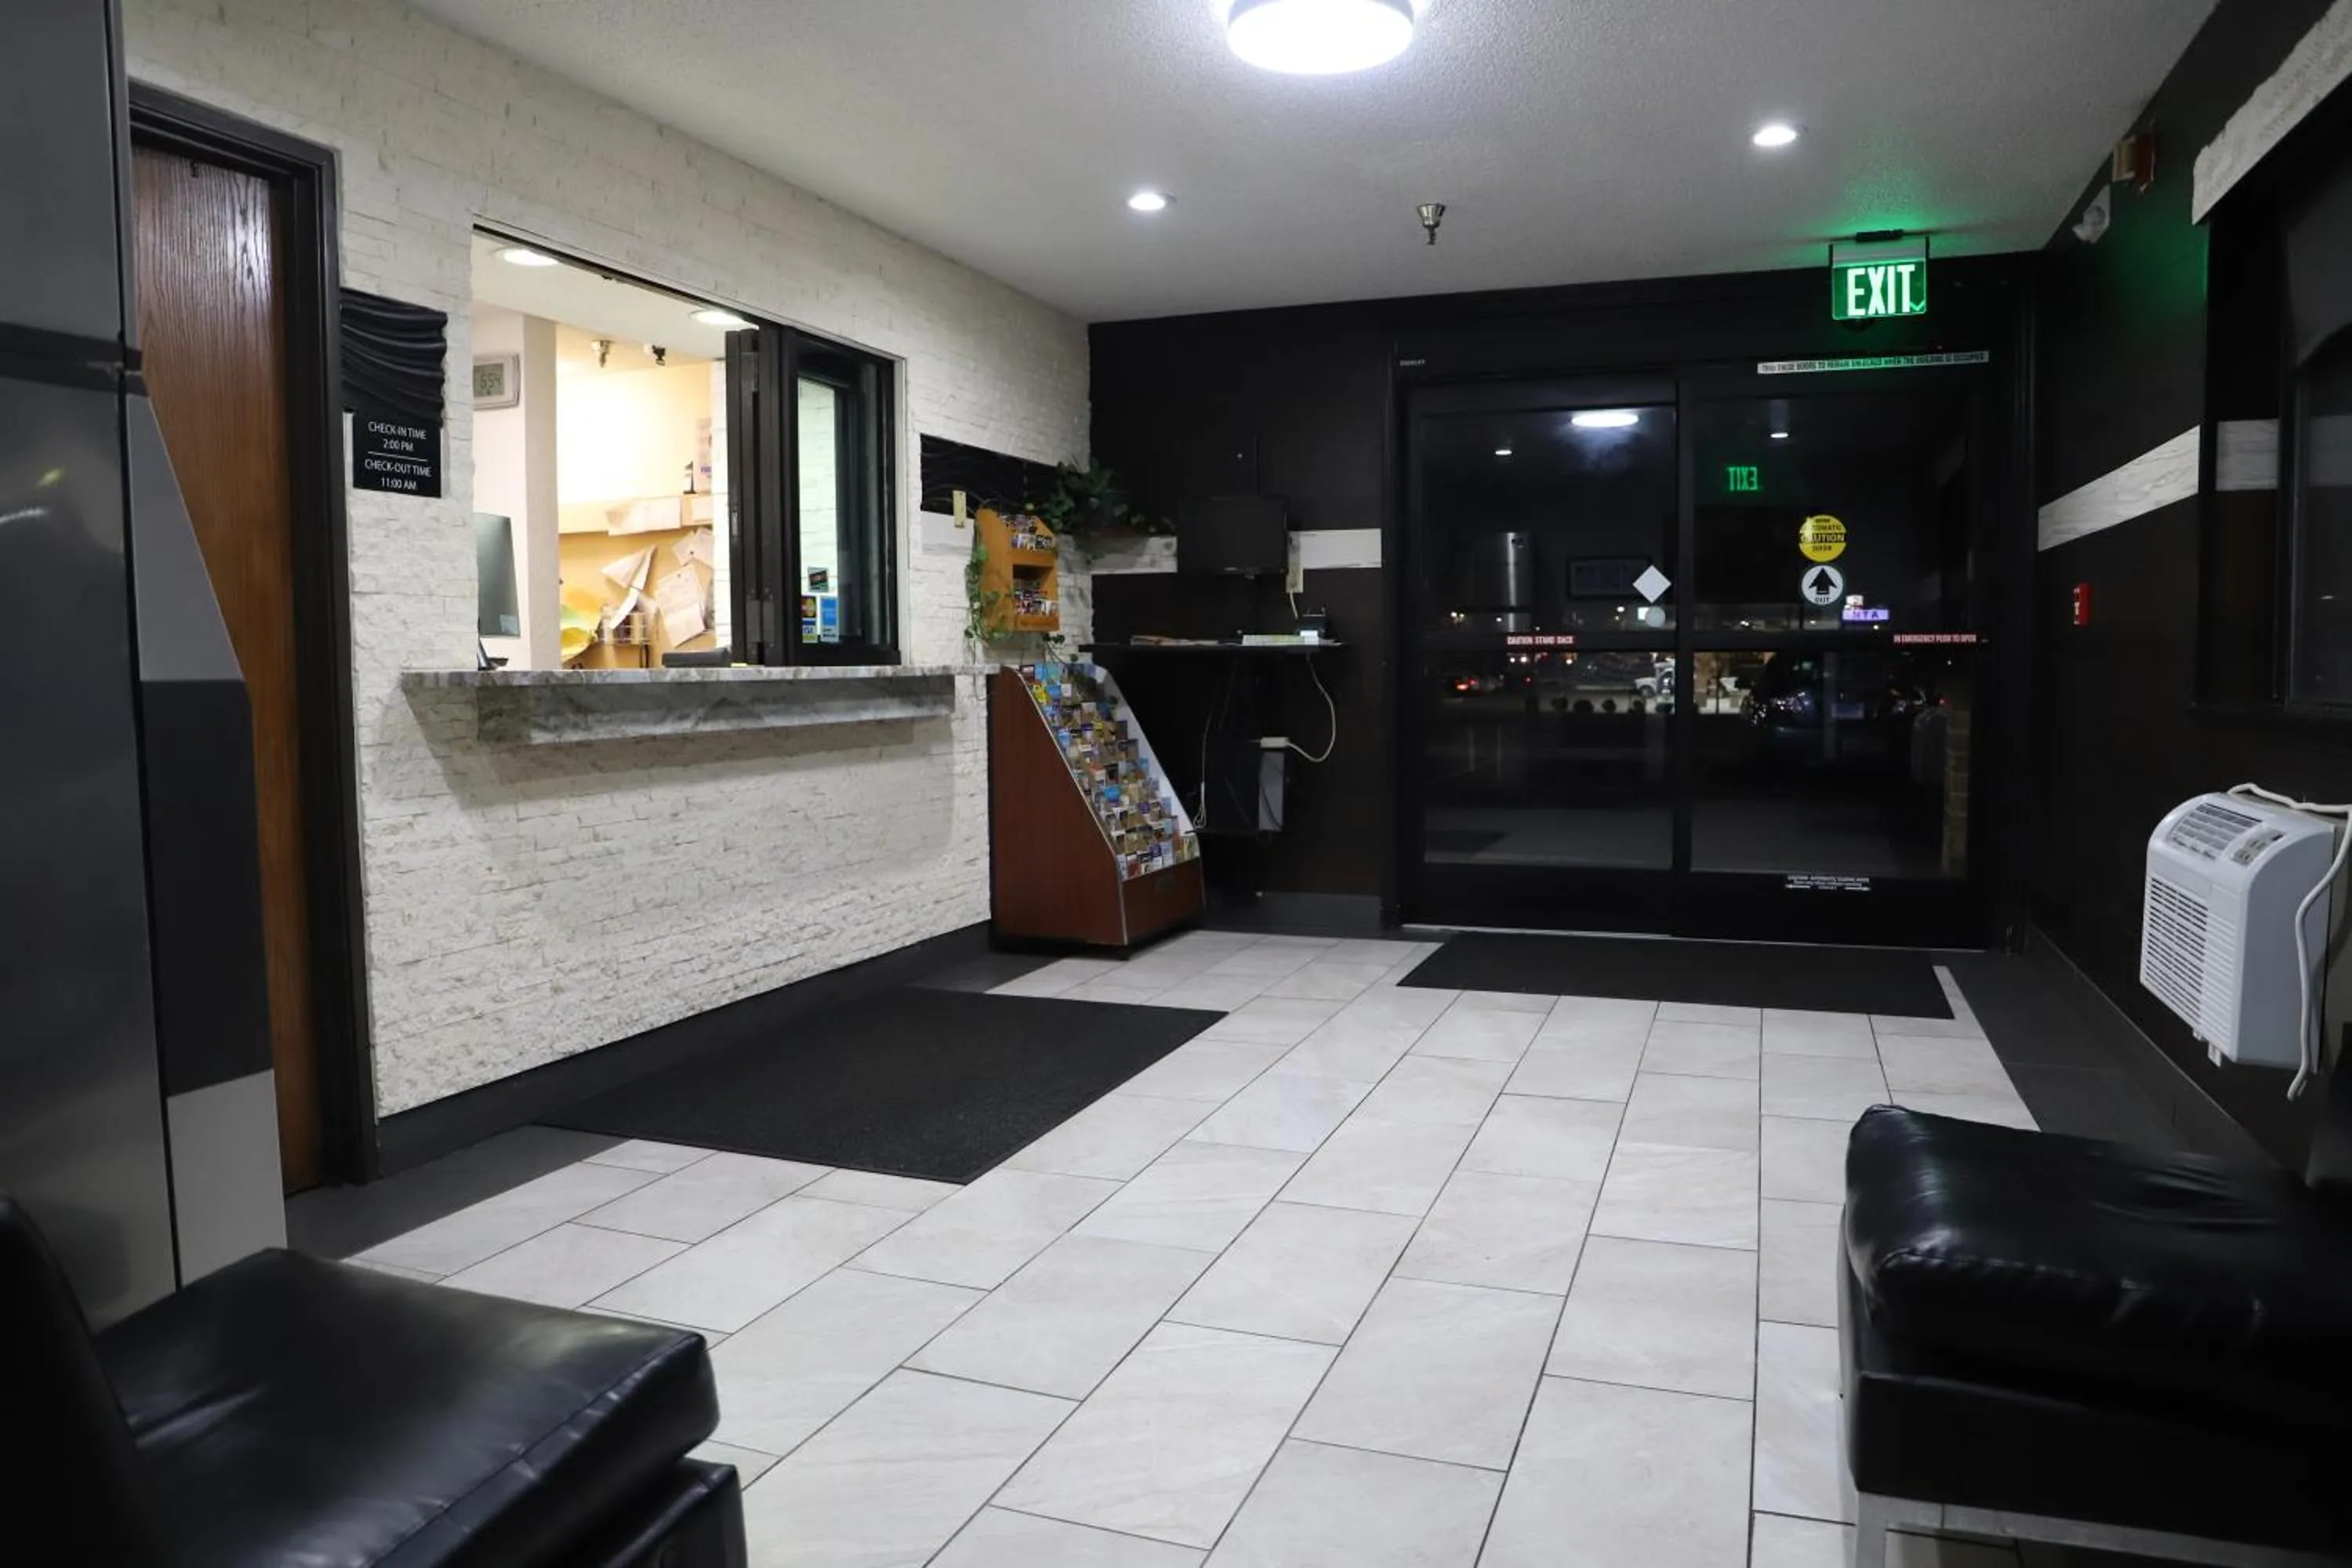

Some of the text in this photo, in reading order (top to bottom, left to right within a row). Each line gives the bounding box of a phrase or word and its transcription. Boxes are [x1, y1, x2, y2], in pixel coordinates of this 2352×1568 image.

[1847, 264, 1915, 316] EXIT
[368, 421, 427, 440] CHECK-IN TIME
[383, 438, 415, 452] 2:00 PM
[365, 459, 433, 477] CHECK-OUT TIME
[381, 477, 417, 491] 11:00 AM
